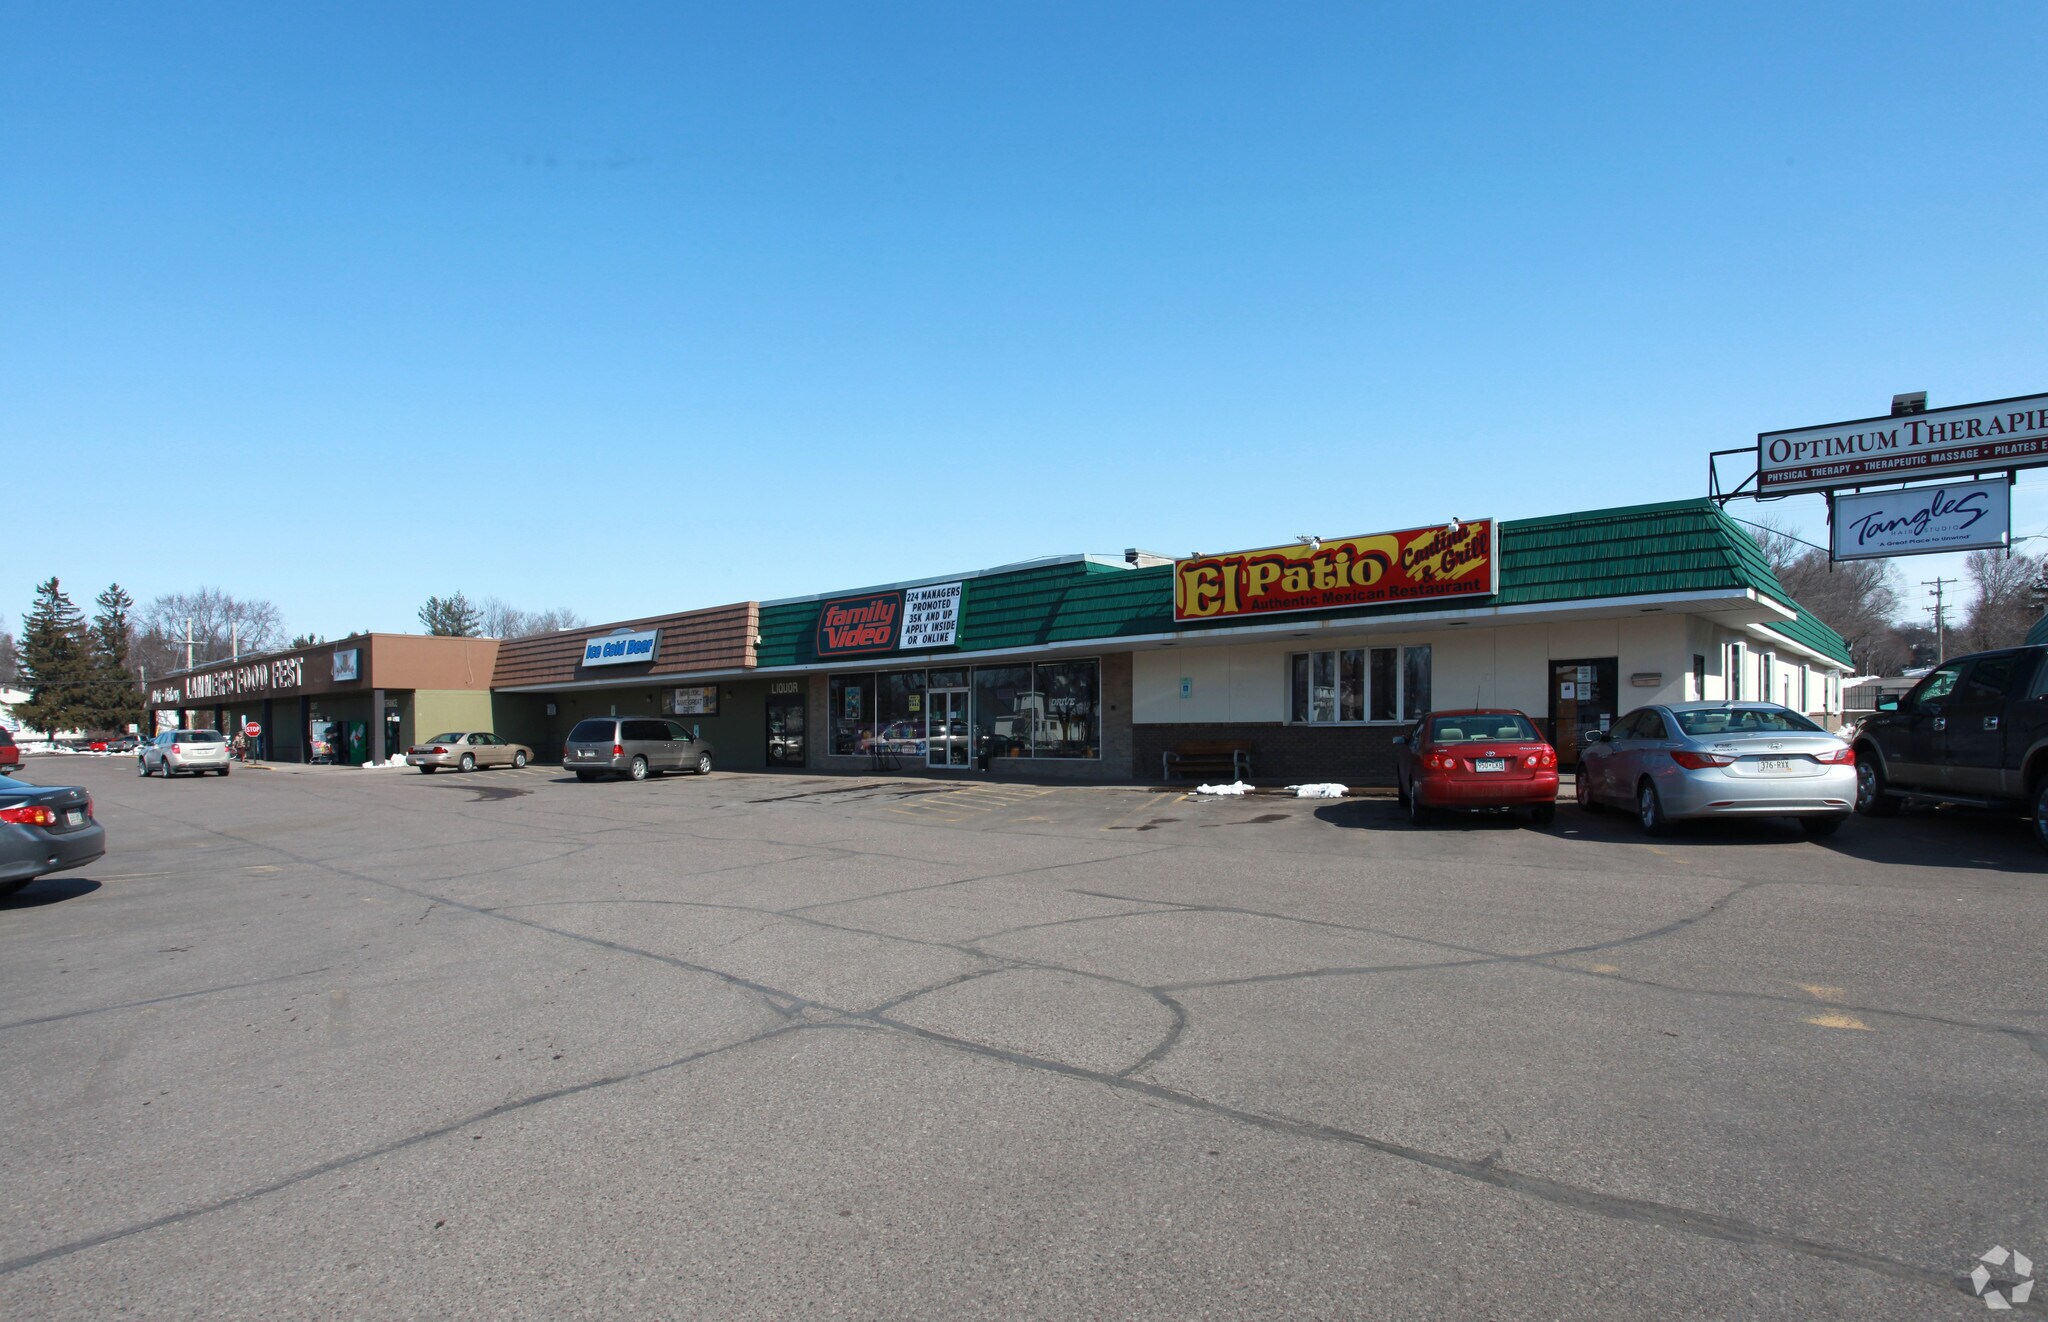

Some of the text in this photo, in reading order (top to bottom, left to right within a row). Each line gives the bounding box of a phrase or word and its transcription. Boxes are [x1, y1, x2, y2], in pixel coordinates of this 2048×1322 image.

[1768, 429, 1899, 464] OPTIMUM
[1767, 469, 1808, 482] PHYSICAL
[1811, 464, 1851, 477] THERAPY
[1864, 456, 1927, 471] THERAPEUTIC
[1931, 448, 1979, 462] MASSAGE
[1994, 441, 2037, 455] PILATES
[1924, 525, 1959, 533] STUDIO
[1401, 526, 1470, 571] Cantina
[1422, 533, 1487, 583] & Grill
[1182, 550, 1386, 617] El Patio
[906, 586, 961, 602] 224 MANAGERS
[1251, 578, 1481, 611] Authentic Mexican Restaurant
[912, 599, 951, 612] PROMOTED
[909, 609, 953, 623] 35K AND UP
[823, 624, 892, 649] Video
[905, 619, 956, 635] APPLY INSIDE
[907, 632, 950, 645] OR ONLINE
[585, 639, 653, 659] Ice Cold Beer
[236, 664, 268, 694] FOOD
[272, 656, 304, 689] FEST
[771, 682, 799, 694] LIQUOR
[1051, 696, 1076, 706] DRIVE
